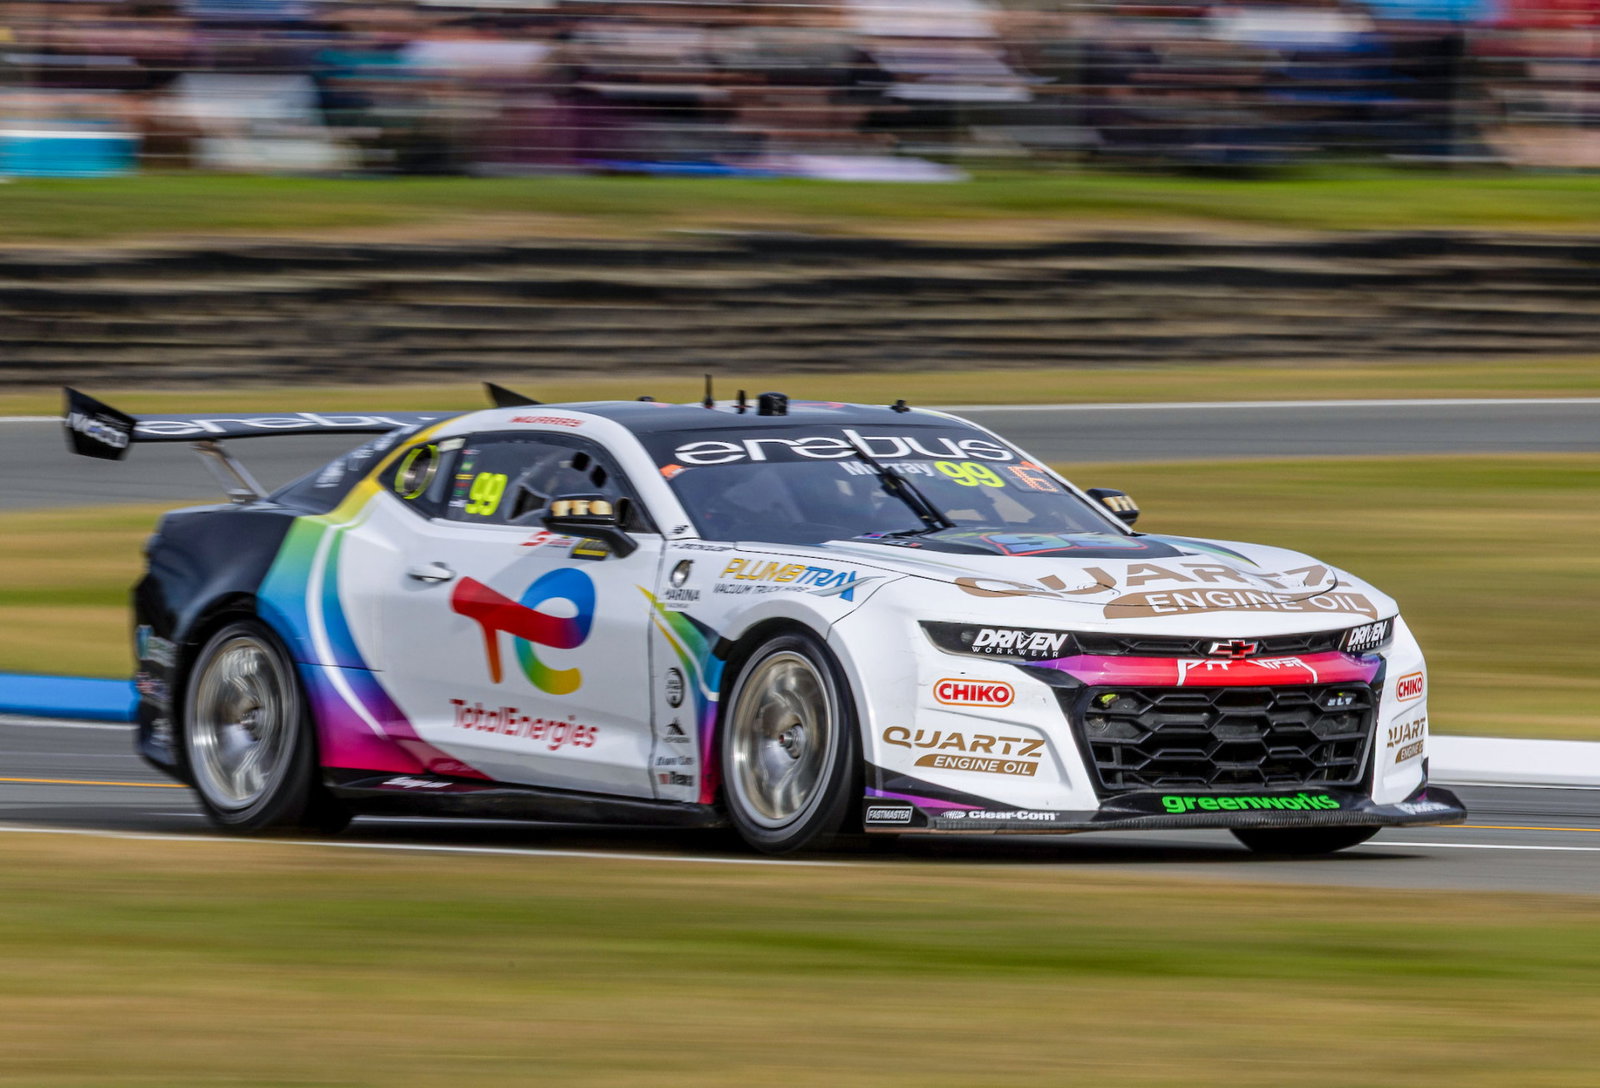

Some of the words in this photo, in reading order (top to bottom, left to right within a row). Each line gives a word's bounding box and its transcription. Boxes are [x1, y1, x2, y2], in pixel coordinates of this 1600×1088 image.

[135, 411, 441, 434] erebu
[674, 429, 1014, 465] erebus
[934, 461, 1006, 488] 99
[464, 472, 508, 515] 99
[954, 563, 1353, 599] QUARTZ
[1148, 591, 1303, 613] ENGINE
[1308, 594, 1371, 613] OIL
[973, 629, 1069, 651] DRIVEN
[1347, 620, 1388, 648] DRIVEN
[972, 646, 1059, 658] WORKWEAR
[939, 683, 1010, 703] CHIKO
[1398, 677, 1424, 698] CHIKO
[449, 698, 599, 750] TotalEnergies
[882, 726, 1046, 758] QUARTZ
[934, 756, 997, 772] ENGINE
[1003, 763, 1032, 775] OIL
[1162, 793, 1341, 813] greenworks
[868, 810, 911, 820] FASTMASTER
[968, 811, 1057, 820] Clear-Com
